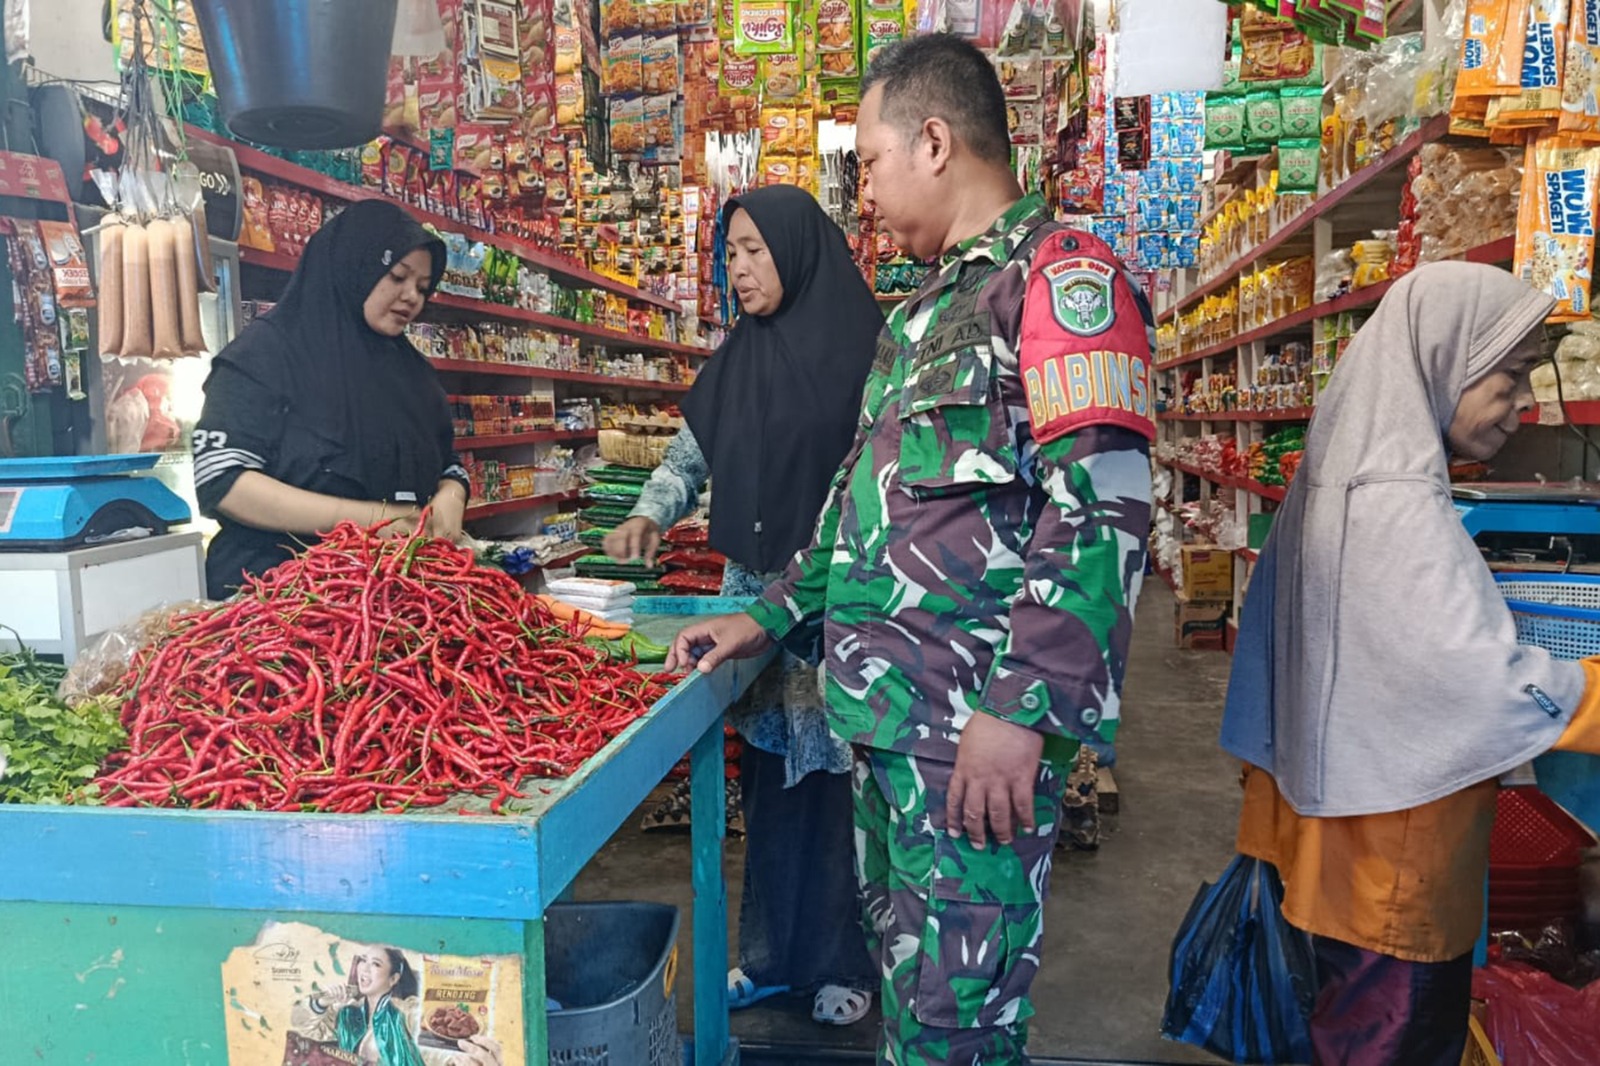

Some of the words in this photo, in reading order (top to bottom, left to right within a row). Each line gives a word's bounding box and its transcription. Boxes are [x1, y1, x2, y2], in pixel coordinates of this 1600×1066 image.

[742, 17, 786, 37] Sajiku
[869, 22, 900, 38] Sajiku
[1586, 0, 1598, 45] AGETI
[1464, 39, 1475, 68] WOW
[1541, 23, 1557, 86] SPAGETI
[1547, 172, 1565, 234] SPAGETI
[1561, 169, 1594, 236] WOW
[918, 335, 944, 361] TNI
[951, 320, 981, 343] AD
[1024, 350, 1156, 430] BABINS
[436, 988, 476, 1001] RENDANG
